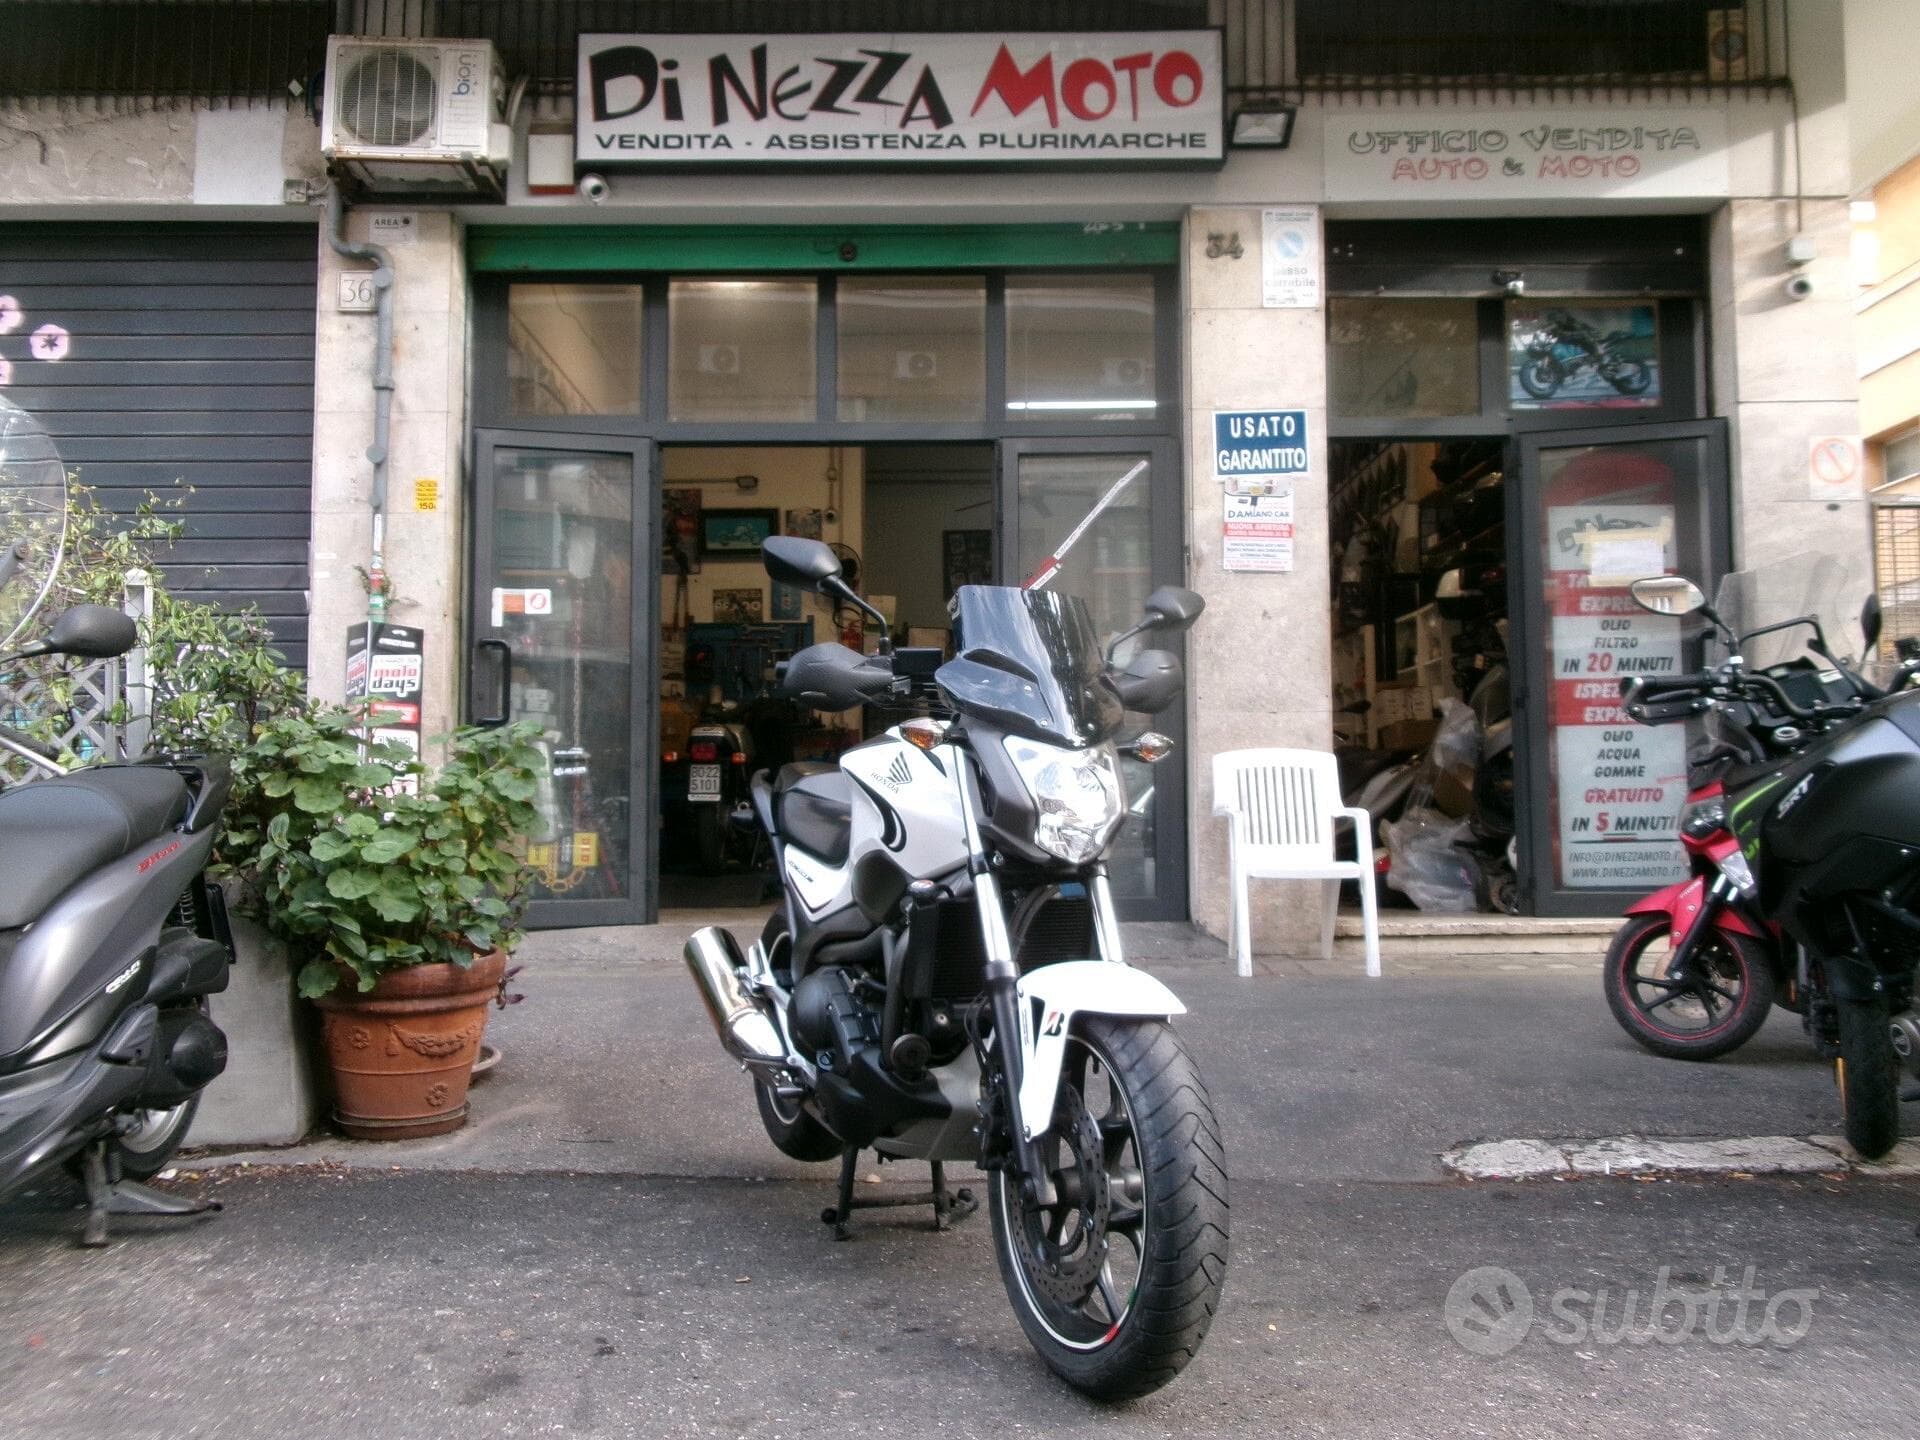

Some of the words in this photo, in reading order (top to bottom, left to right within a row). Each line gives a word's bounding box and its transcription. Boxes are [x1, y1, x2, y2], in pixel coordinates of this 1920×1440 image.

[589, 46, 684, 123] Di
[971, 41, 1203, 129] MOTO
[595, 133, 733, 150] VENDITA
[765, 133, 967, 150] ASSISTENZA
[979, 132, 1208, 149] PLURIMARCHE
[1348, 130, 1509, 153] UFFICIO
[1521, 125, 1701, 151] VENDITA
[1392, 157, 1489, 180] AUTO
[1502, 157, 1525, 176] &
[1538, 154, 1641, 178] MOTO
[342, 279, 373, 302] 36
[1229, 415, 1296, 439] USATO
[1218, 447, 1306, 472] GARANTITO
[1601, 619, 1632, 631] OLIO
[1594, 637, 1639, 649] FILTRO
[1563, 658, 1581, 673] IN
[1587, 652, 1613, 673] 20
[1616, 656, 1673, 672] MINUTI
[372, 676, 416, 693] days
[1603, 731, 1634, 742] OLIO
[1597, 748, 1641, 761] ACQUA
[1594, 766, 1646, 778] GOMME
[1584, 787, 1665, 804] GRATUITO
[1571, 817, 1590, 832] IN
[1595, 812, 1610, 832] 5
